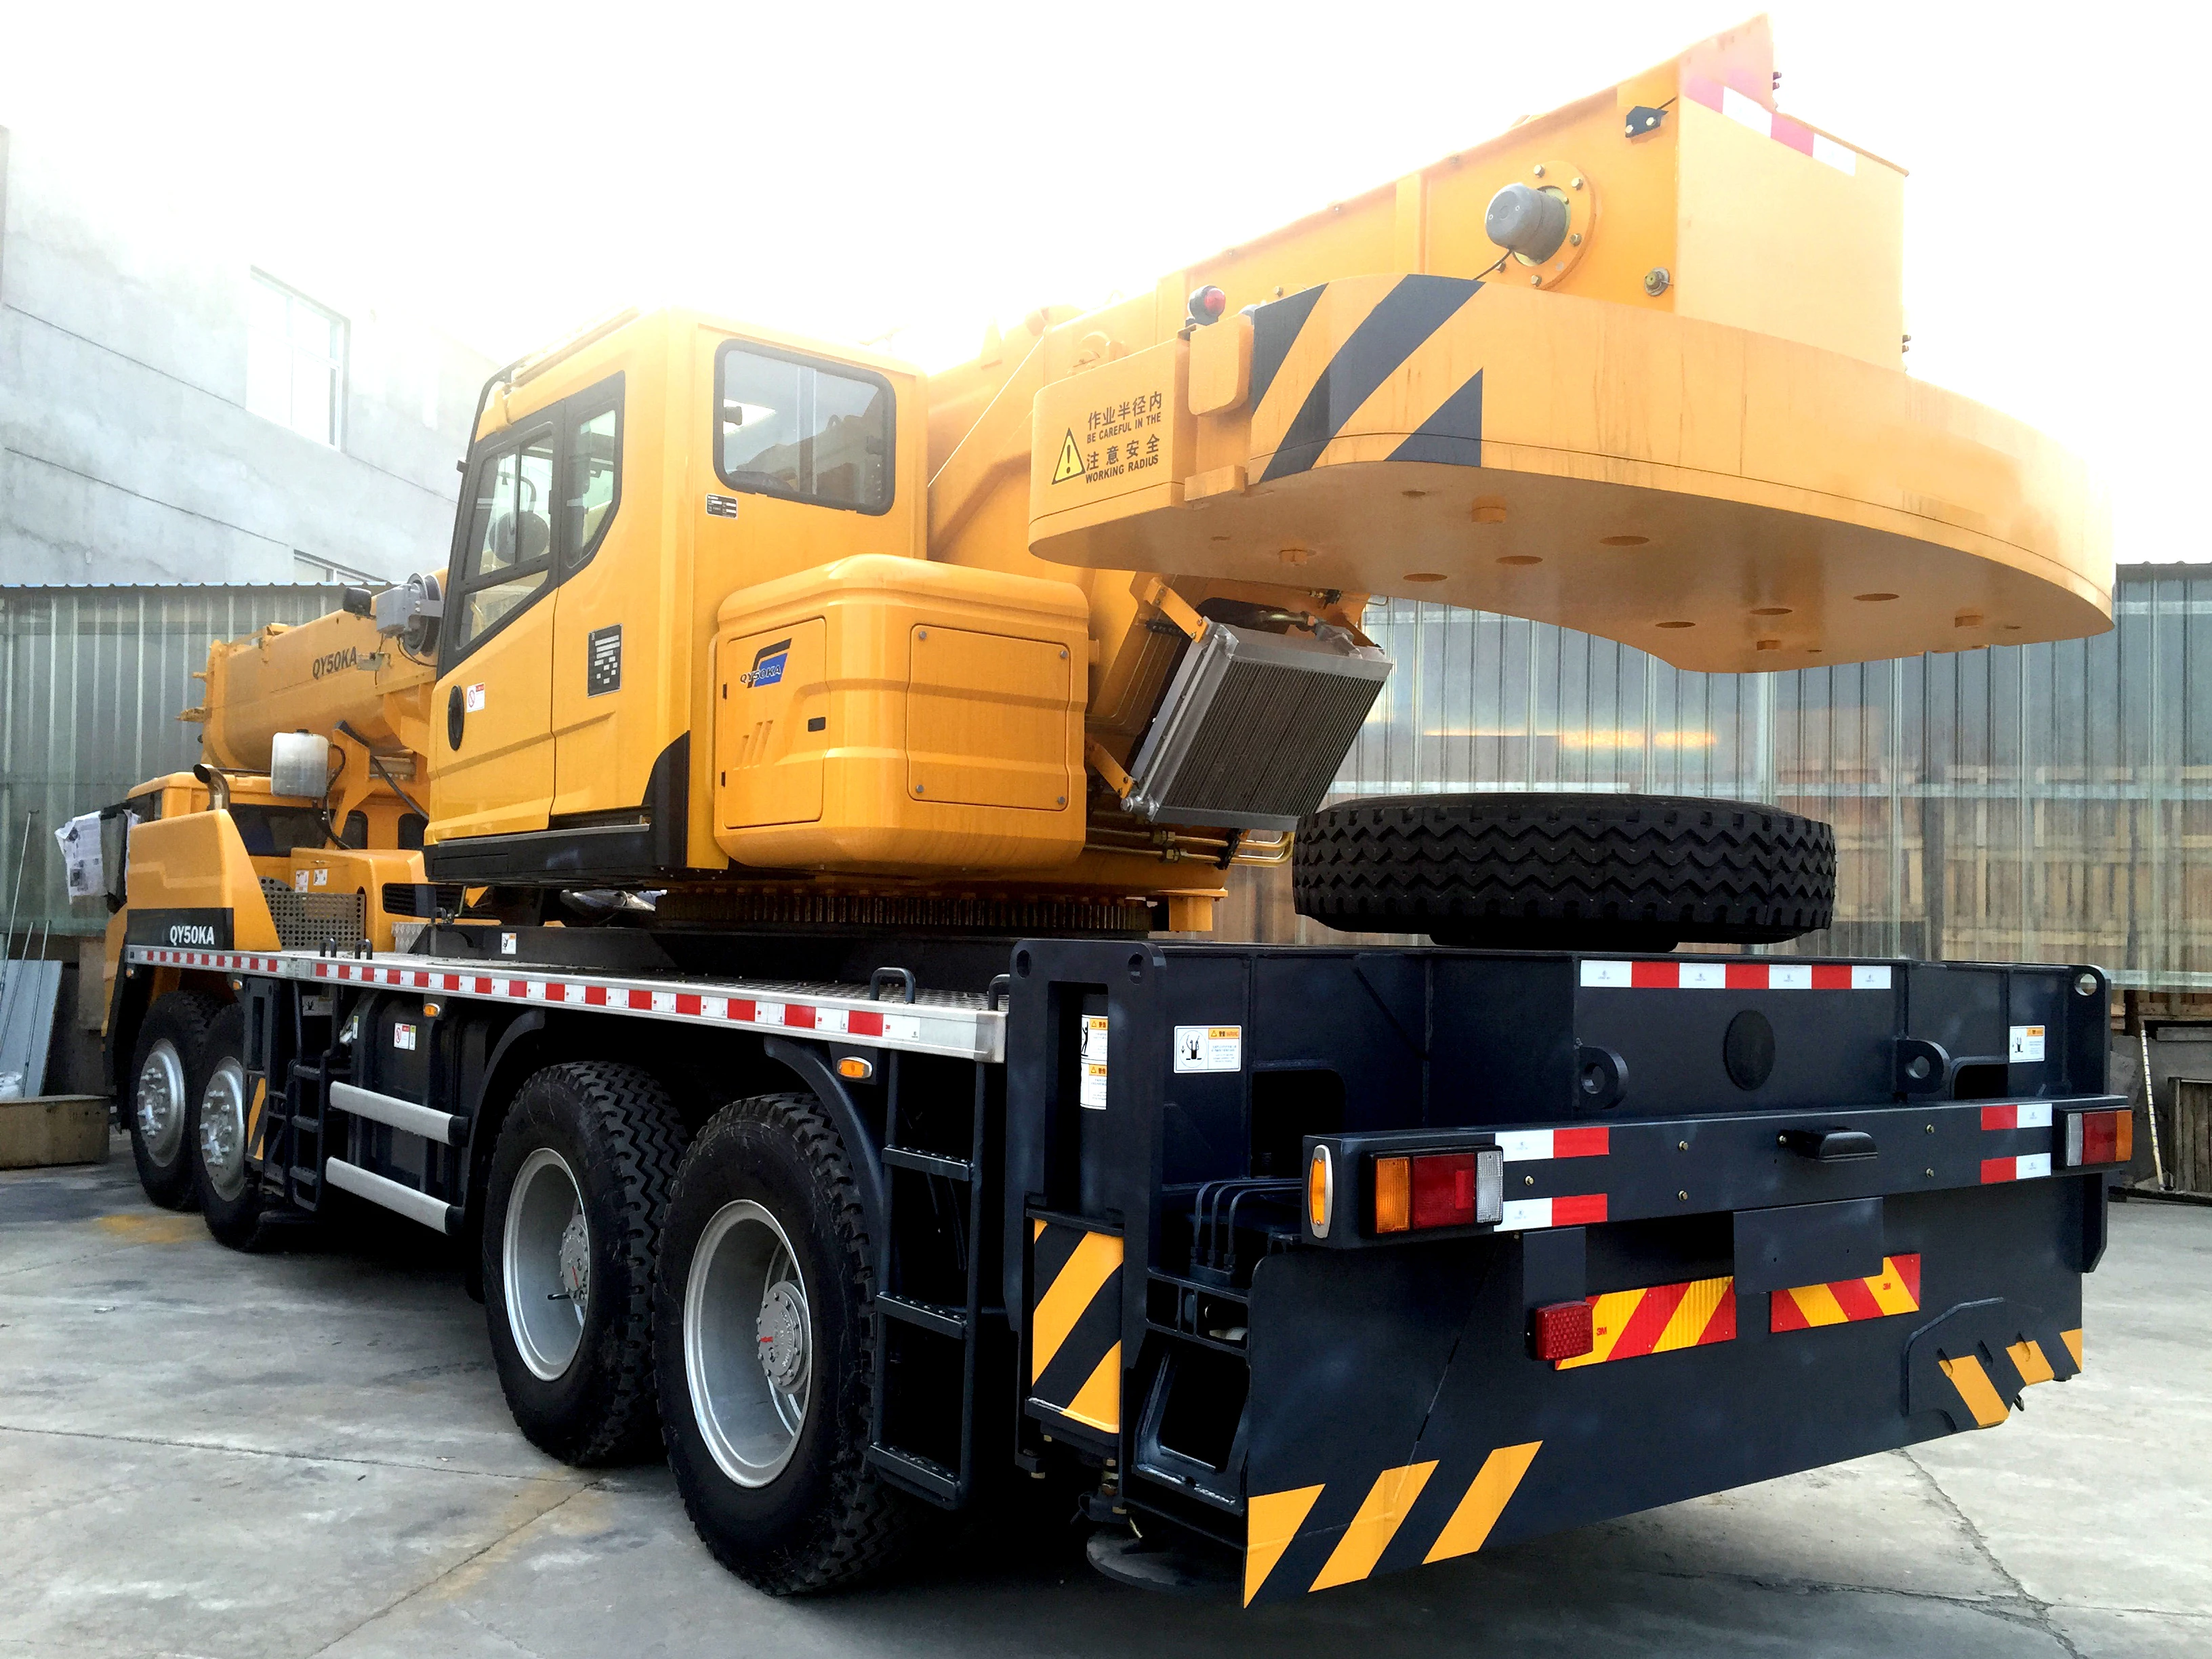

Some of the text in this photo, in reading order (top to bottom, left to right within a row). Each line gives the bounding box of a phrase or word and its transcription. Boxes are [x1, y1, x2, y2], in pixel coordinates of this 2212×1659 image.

[1088, 391, 1162, 431] 作业半径内
[1086, 411, 1162, 444] BE CAREFUL IN THE
[1085, 453, 1159, 484] WORKING RADIUS
[312, 646, 357, 680] QY50KA
[169, 924, 215, 946] QY50KA
[1596, 1326, 1607, 1336] 3M
